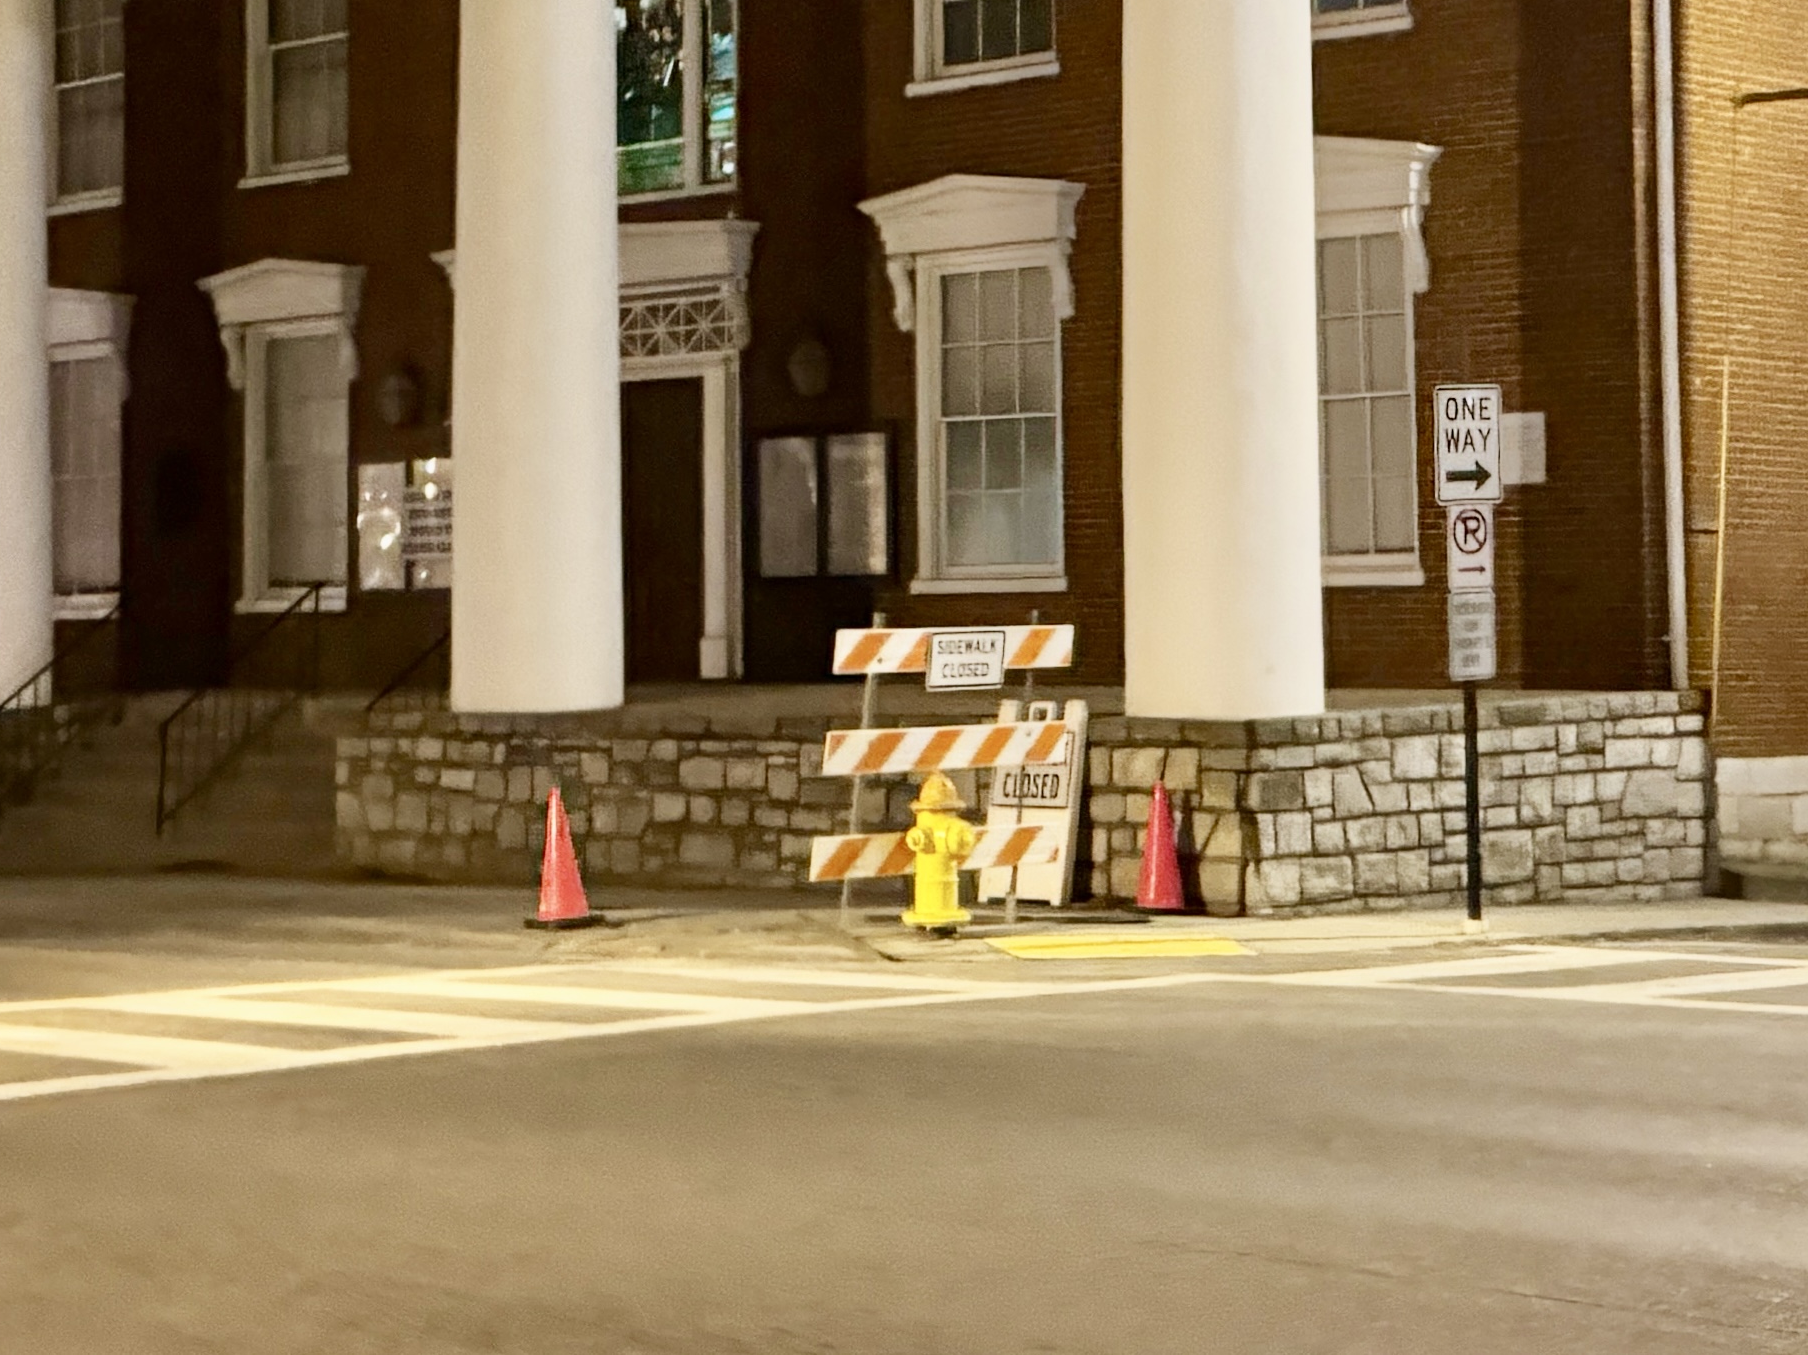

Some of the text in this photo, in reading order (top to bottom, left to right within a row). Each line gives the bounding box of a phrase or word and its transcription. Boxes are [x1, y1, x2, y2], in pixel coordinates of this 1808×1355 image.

[1445, 397, 1492, 421] ONE
[1445, 428, 1492, 453] WAY
[937, 639, 998, 655] SIDEWALK
[942, 662, 990, 678] CLOSED
[1002, 772, 1060, 799] CLOSED
